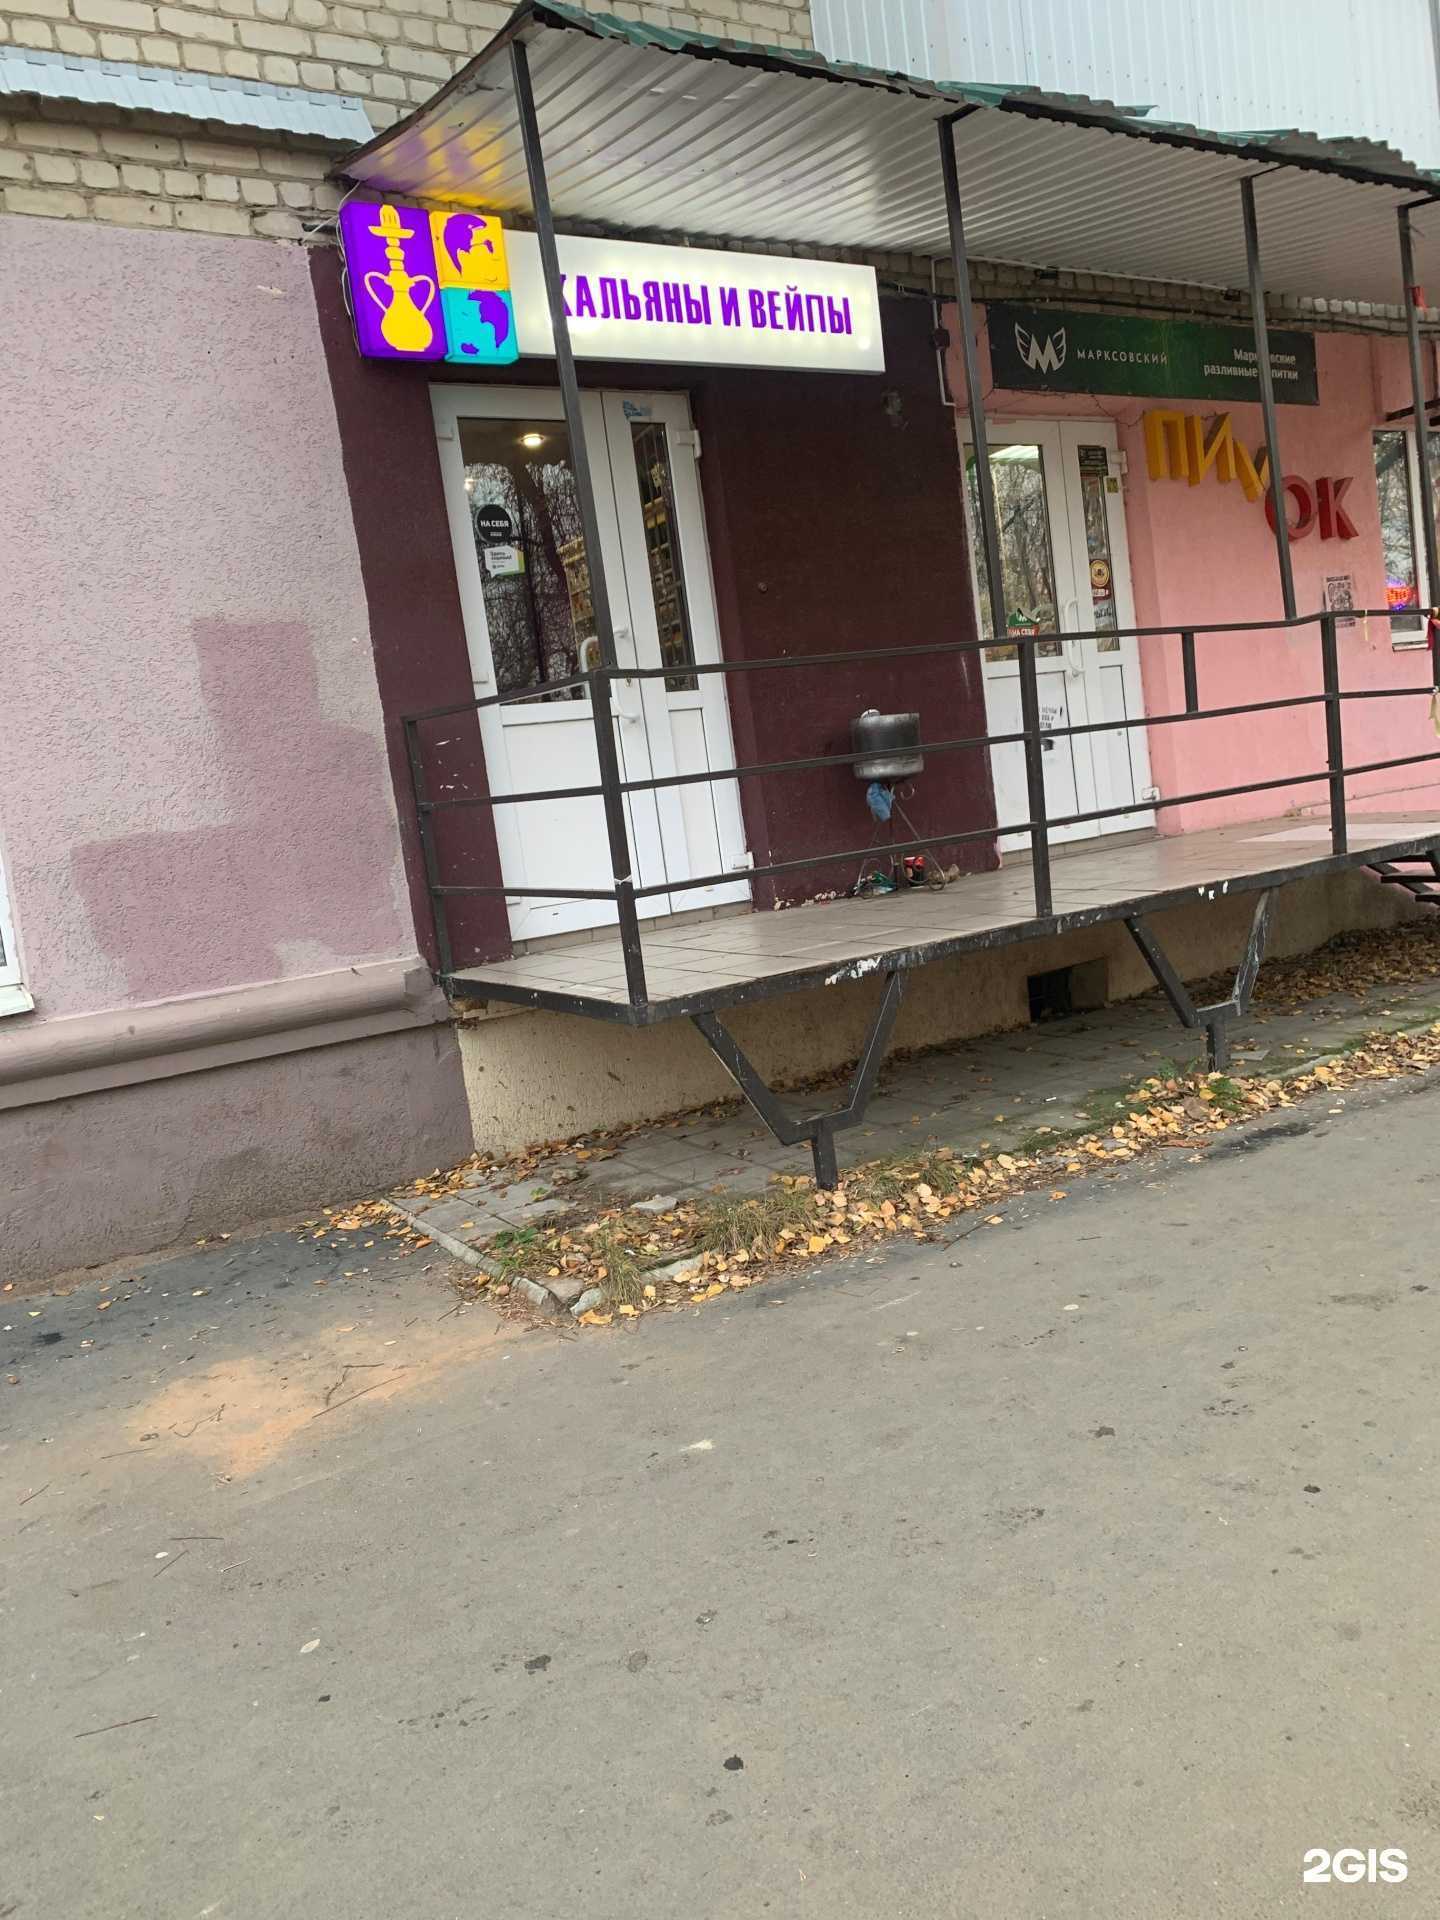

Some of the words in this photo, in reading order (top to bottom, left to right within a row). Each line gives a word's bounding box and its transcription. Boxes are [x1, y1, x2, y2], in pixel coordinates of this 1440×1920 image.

[719, 286, 741, 327] И
[748, 284, 852, 335] ВЕЙПЫ
[1077, 349, 1168, 365] МАРКСОВСКИЙ
[1203, 364, 1258, 377] разливные
[491, 520, 509, 528] СЕБЯ
